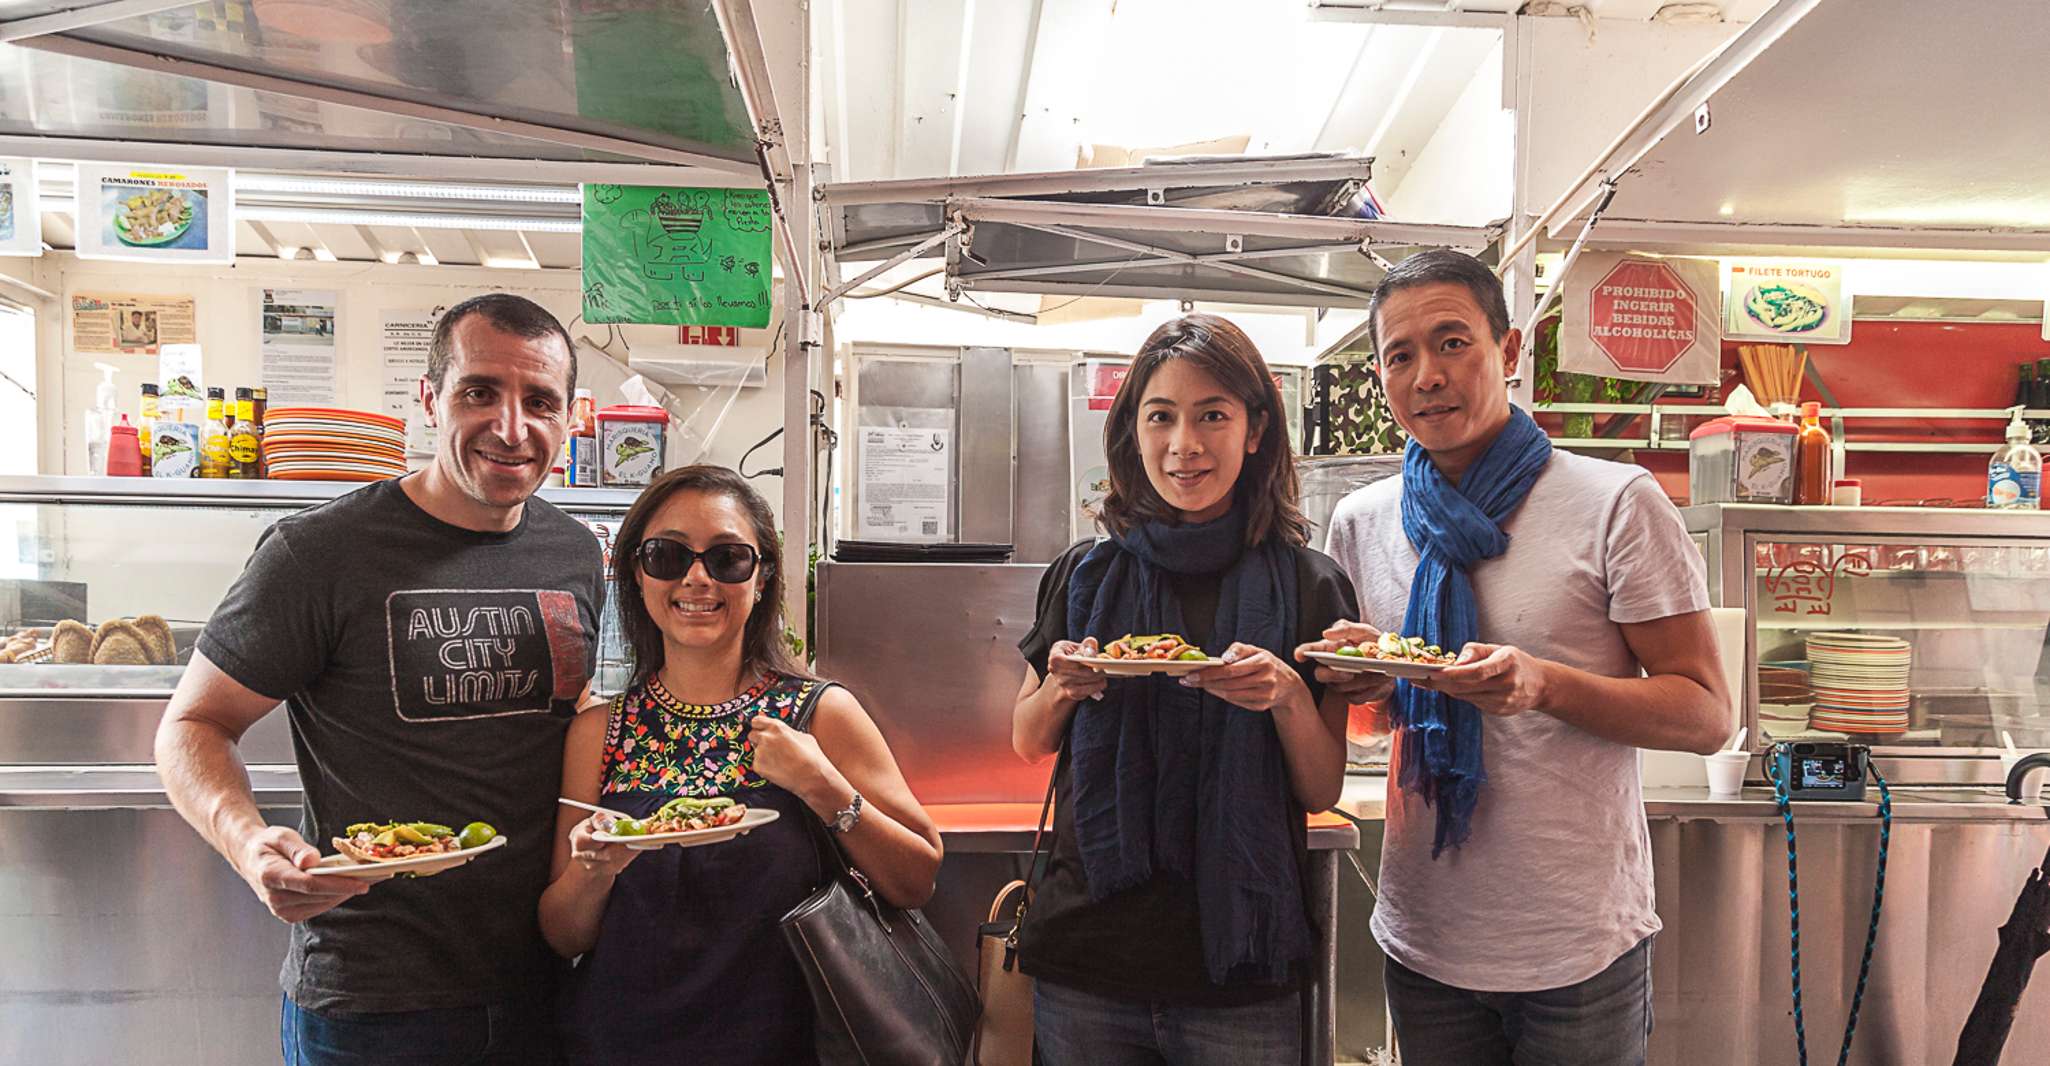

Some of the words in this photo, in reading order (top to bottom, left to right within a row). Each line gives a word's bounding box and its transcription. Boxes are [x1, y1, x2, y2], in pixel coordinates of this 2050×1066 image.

[101, 176, 156, 186] CAMARONES
[1748, 266, 1783, 277] FILETE
[1785, 268, 1831, 279] TORTUGO
[1602, 285, 1687, 300] PROHIBIDO
[1612, 300, 1676, 313] INGERIR
[1612, 313, 1676, 326] BEBIDAS
[1592, 326, 1695, 340] ALCOHOLICAS
[408, 605, 536, 641] AUSTIN
[438, 637, 517, 670] CITY
[423, 668, 539, 705] LIMITS
